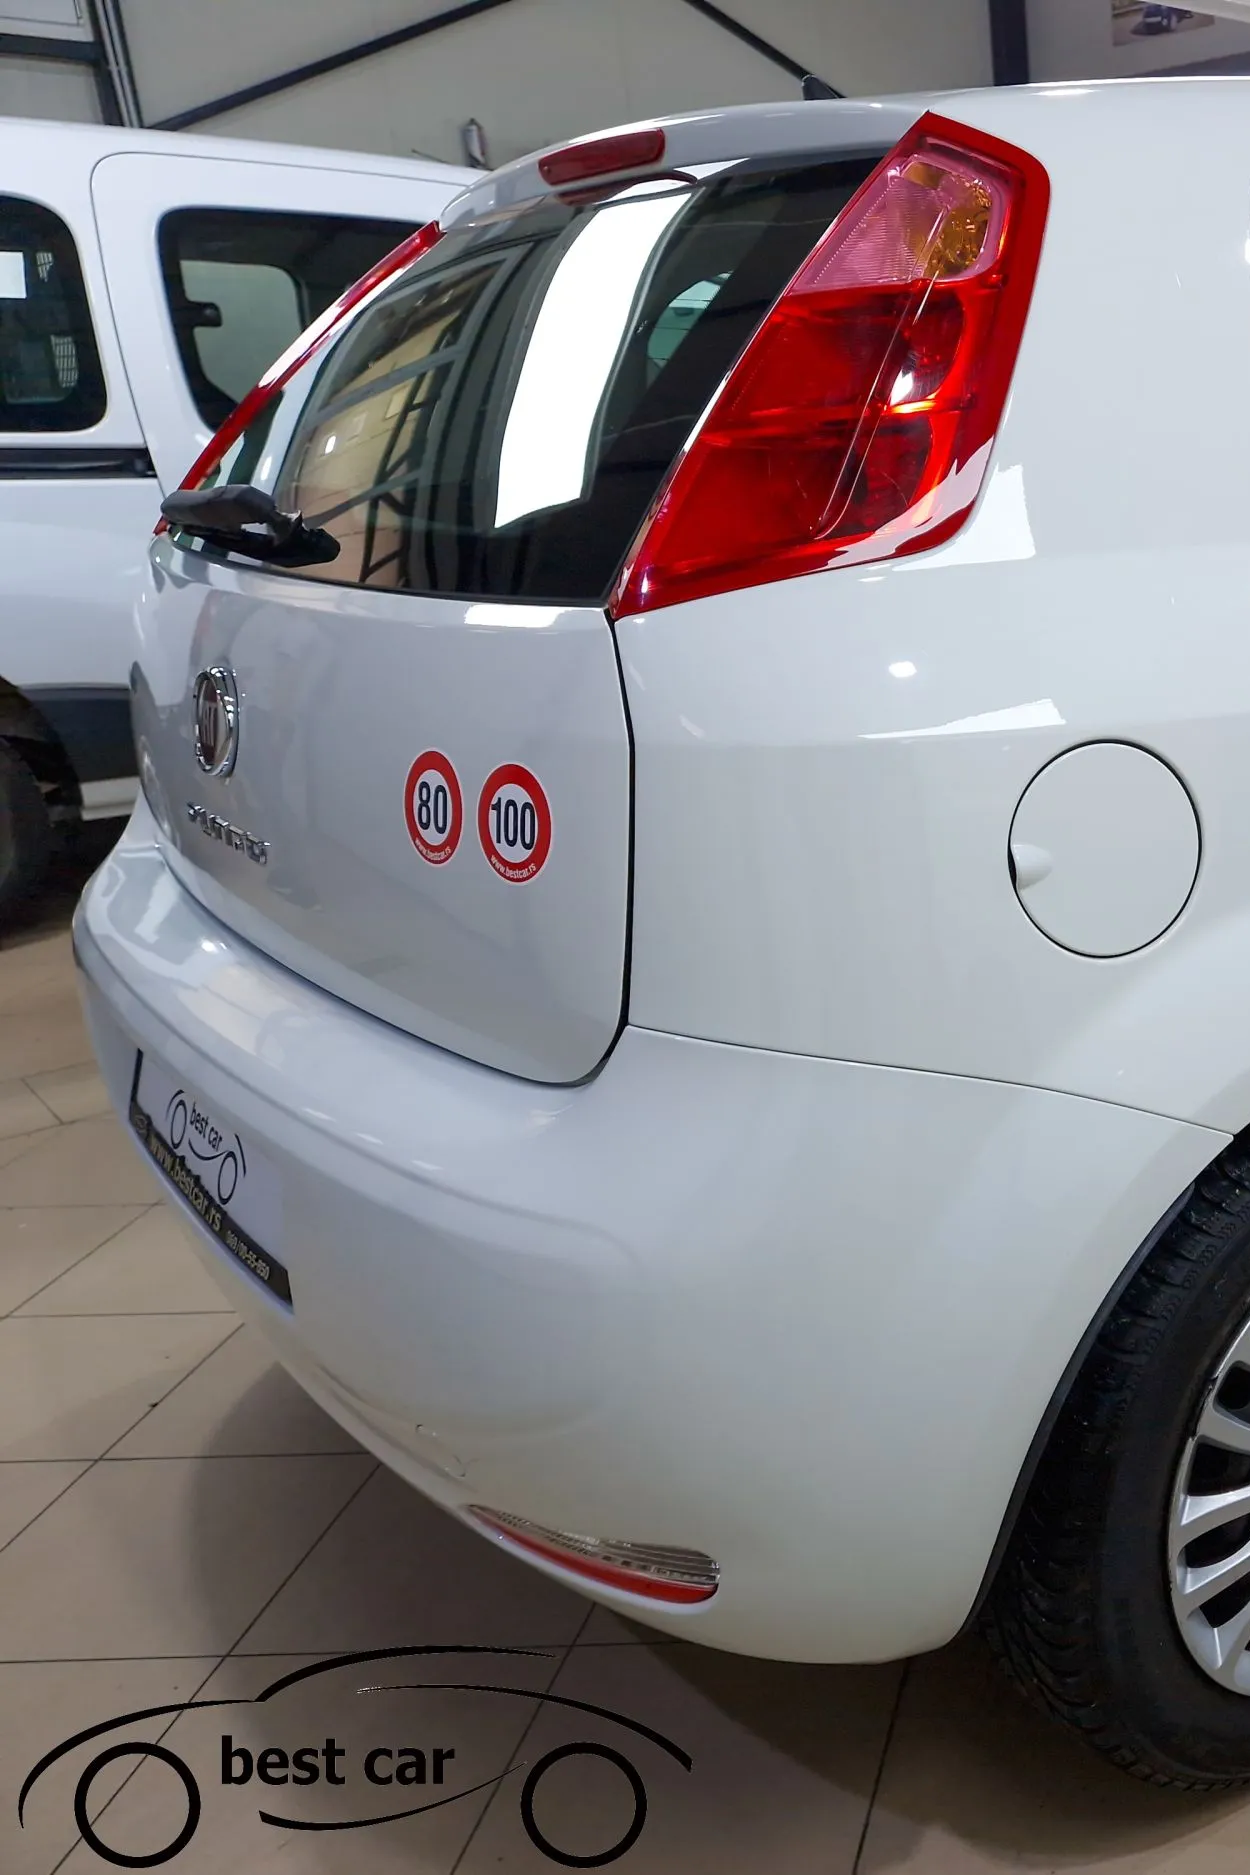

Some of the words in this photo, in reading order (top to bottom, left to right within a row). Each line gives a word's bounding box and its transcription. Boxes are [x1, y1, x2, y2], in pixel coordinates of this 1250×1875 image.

[418, 781, 448, 834] 80
[491, 797, 536, 850] 100
[490, 854, 537, 879] www.bestcar.rs
[190, 1102, 208, 1138] best
[208, 1124, 222, 1150] car
[150, 1134, 221, 1232] www.bestcar.rs
